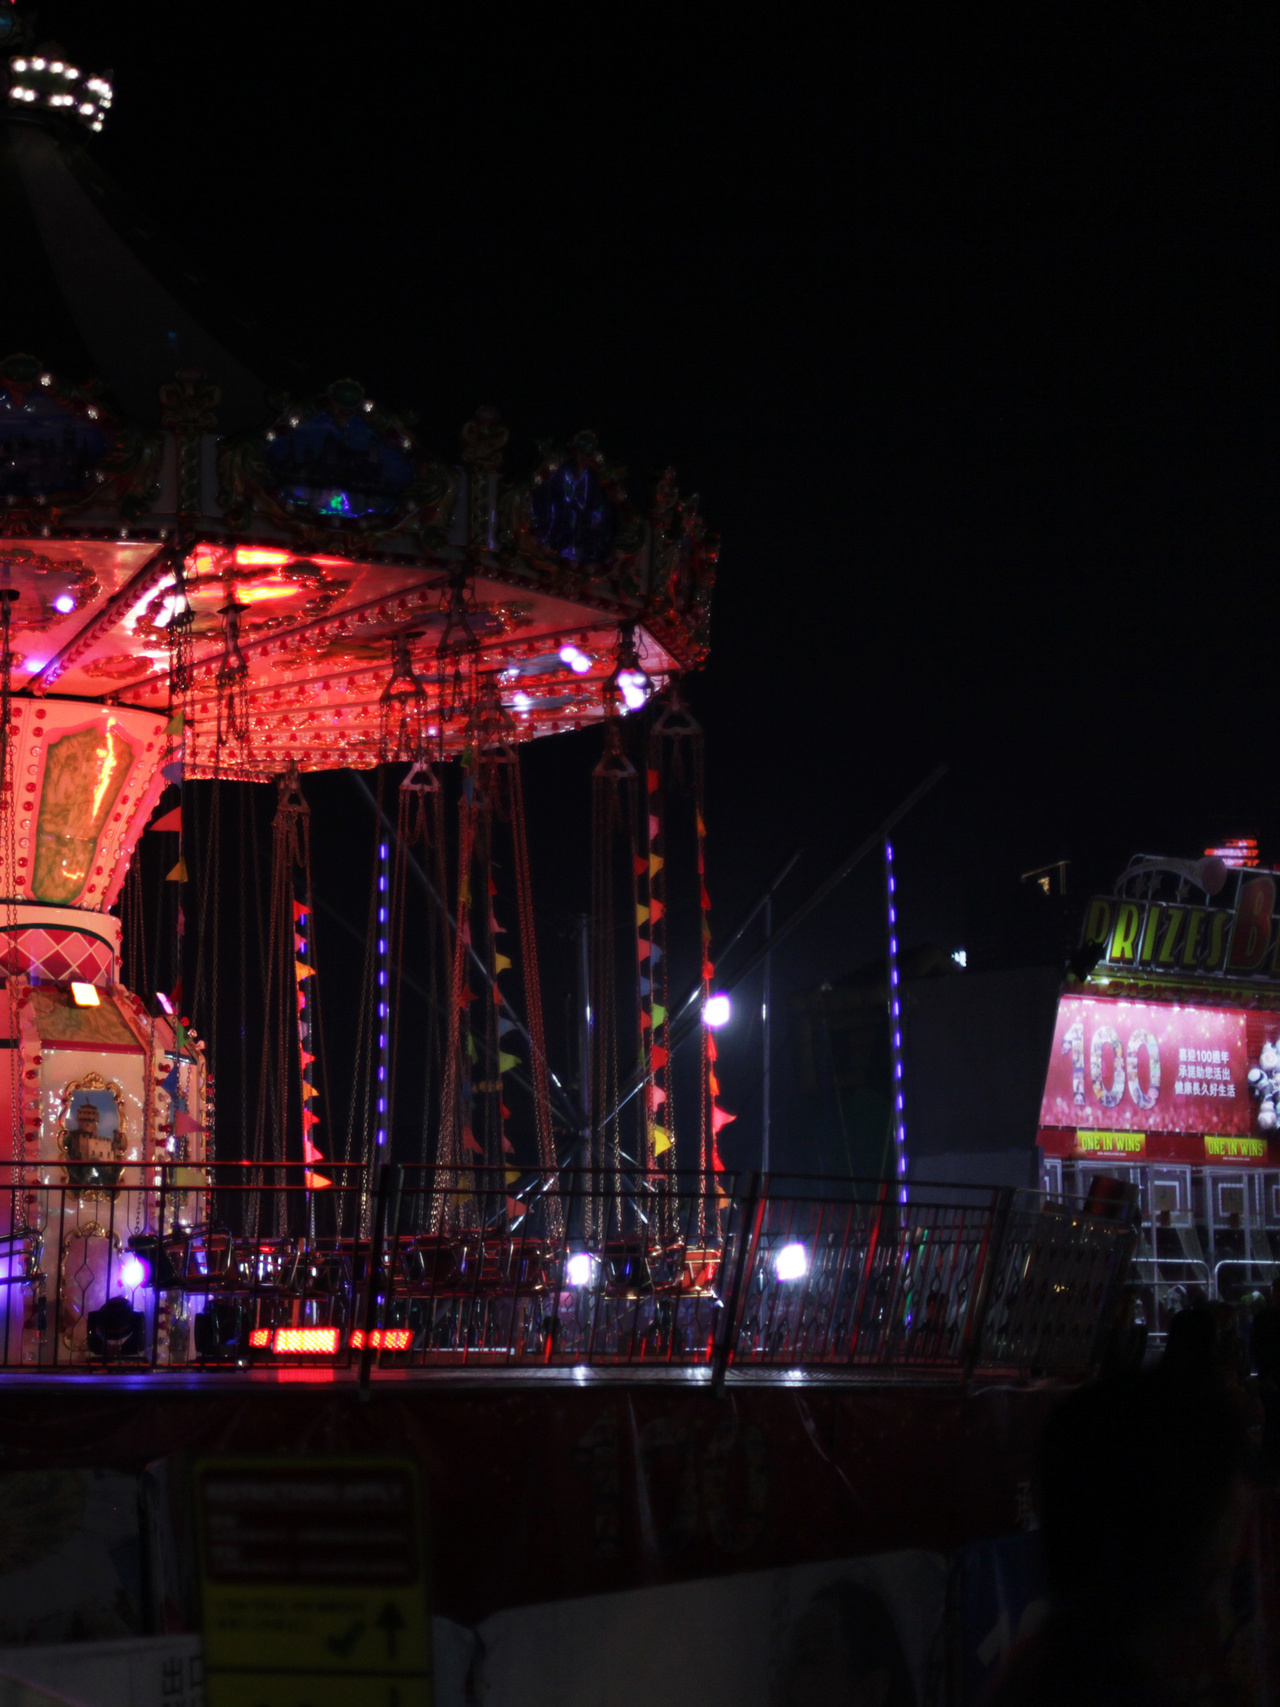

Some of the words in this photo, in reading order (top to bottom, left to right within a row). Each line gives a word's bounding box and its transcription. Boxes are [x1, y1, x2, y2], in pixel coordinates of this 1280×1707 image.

[1083, 899, 1229, 967] PRIZES
[1226, 876, 1280, 971] B
[1060, 1022, 1162, 1110] 100
[1174, 1081, 1236, 1097] 健康長久好生活
[1081, 1135, 1101, 1151] ONE
[1102, 1137, 1114, 1151] IN
[1116, 1137, 1141, 1152] WINS
[1208, 1141, 1226, 1156] ONE
[1227, 1142, 1238, 1156] IN
[1240, 1142, 1264, 1157] WINS
